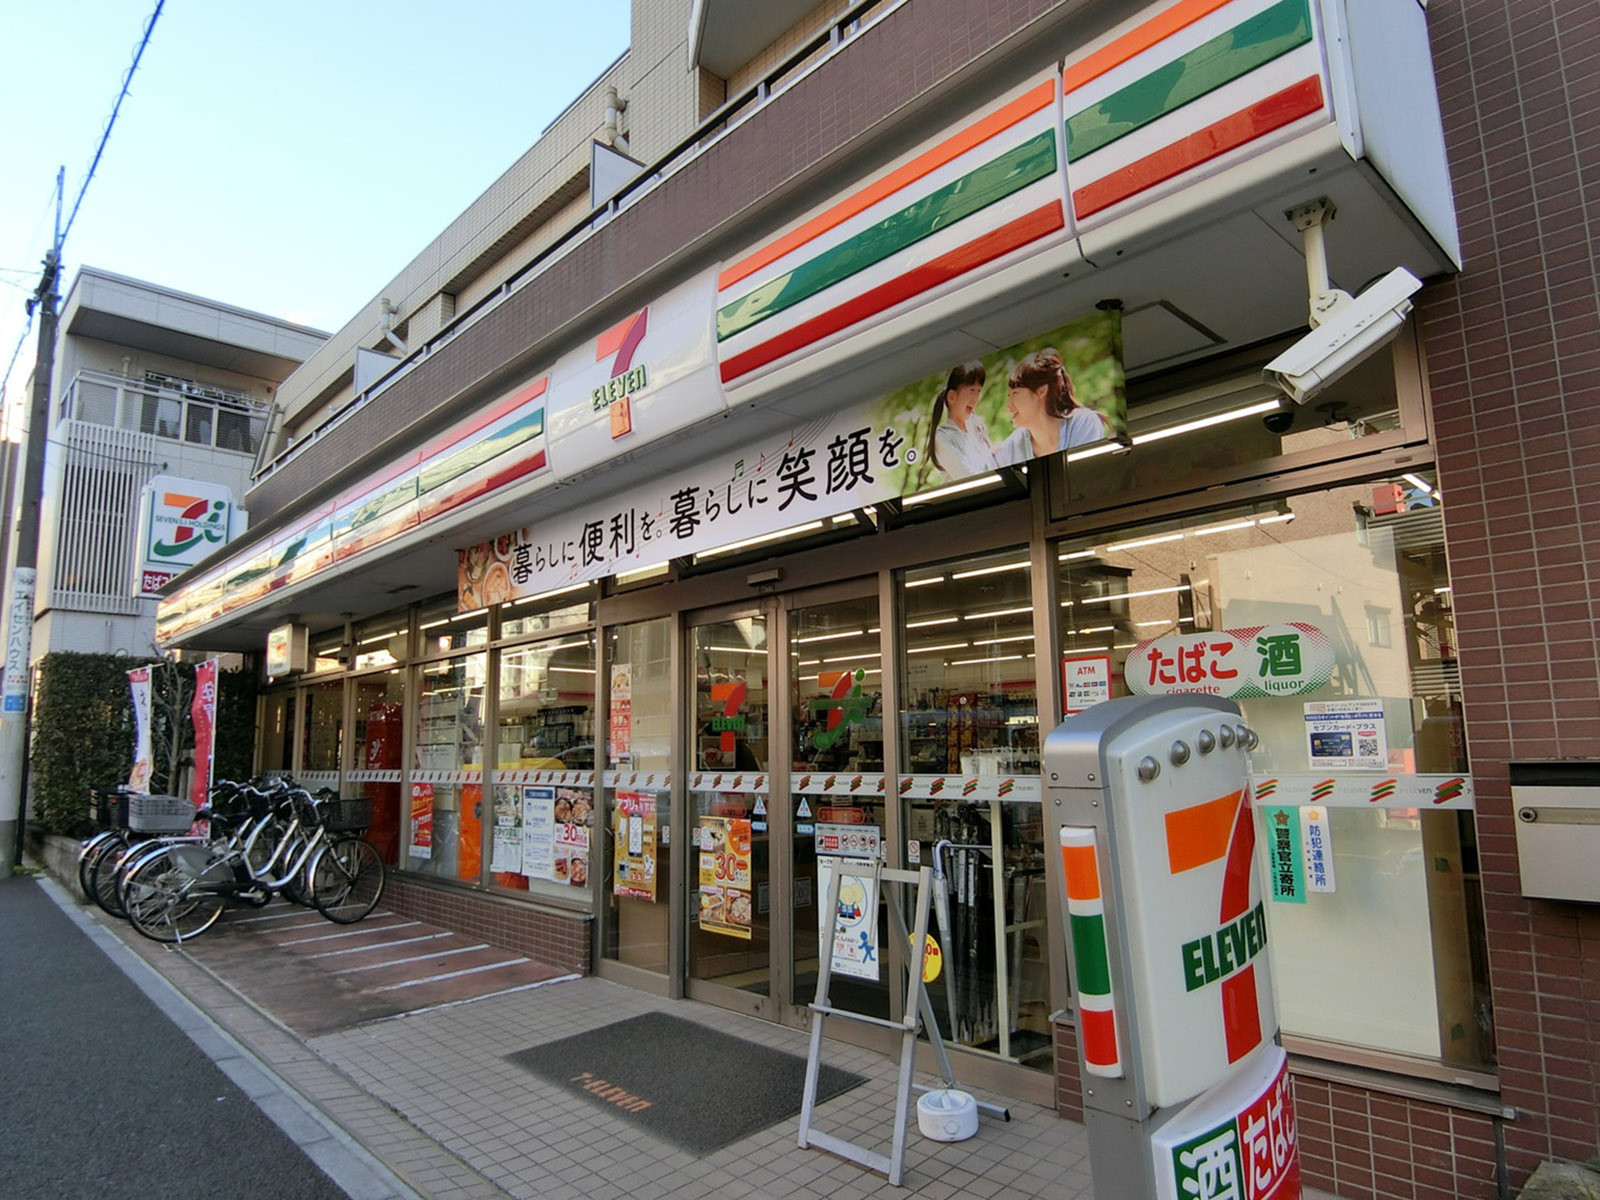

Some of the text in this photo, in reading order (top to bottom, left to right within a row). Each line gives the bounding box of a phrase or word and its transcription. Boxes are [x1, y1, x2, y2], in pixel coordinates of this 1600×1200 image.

[591, 364, 648, 412] ELEVEn
[1077, 666, 1096, 676] ATM
[1147, 633, 1303, 686] たばこ 酒
[1264, 678, 1305, 692] liquor
[1275, 828, 1296, 897] 警察官立寄所
[1309, 824, 1327, 887] 防犯連絡所
[1181, 900, 1268, 993] ELEVEn
